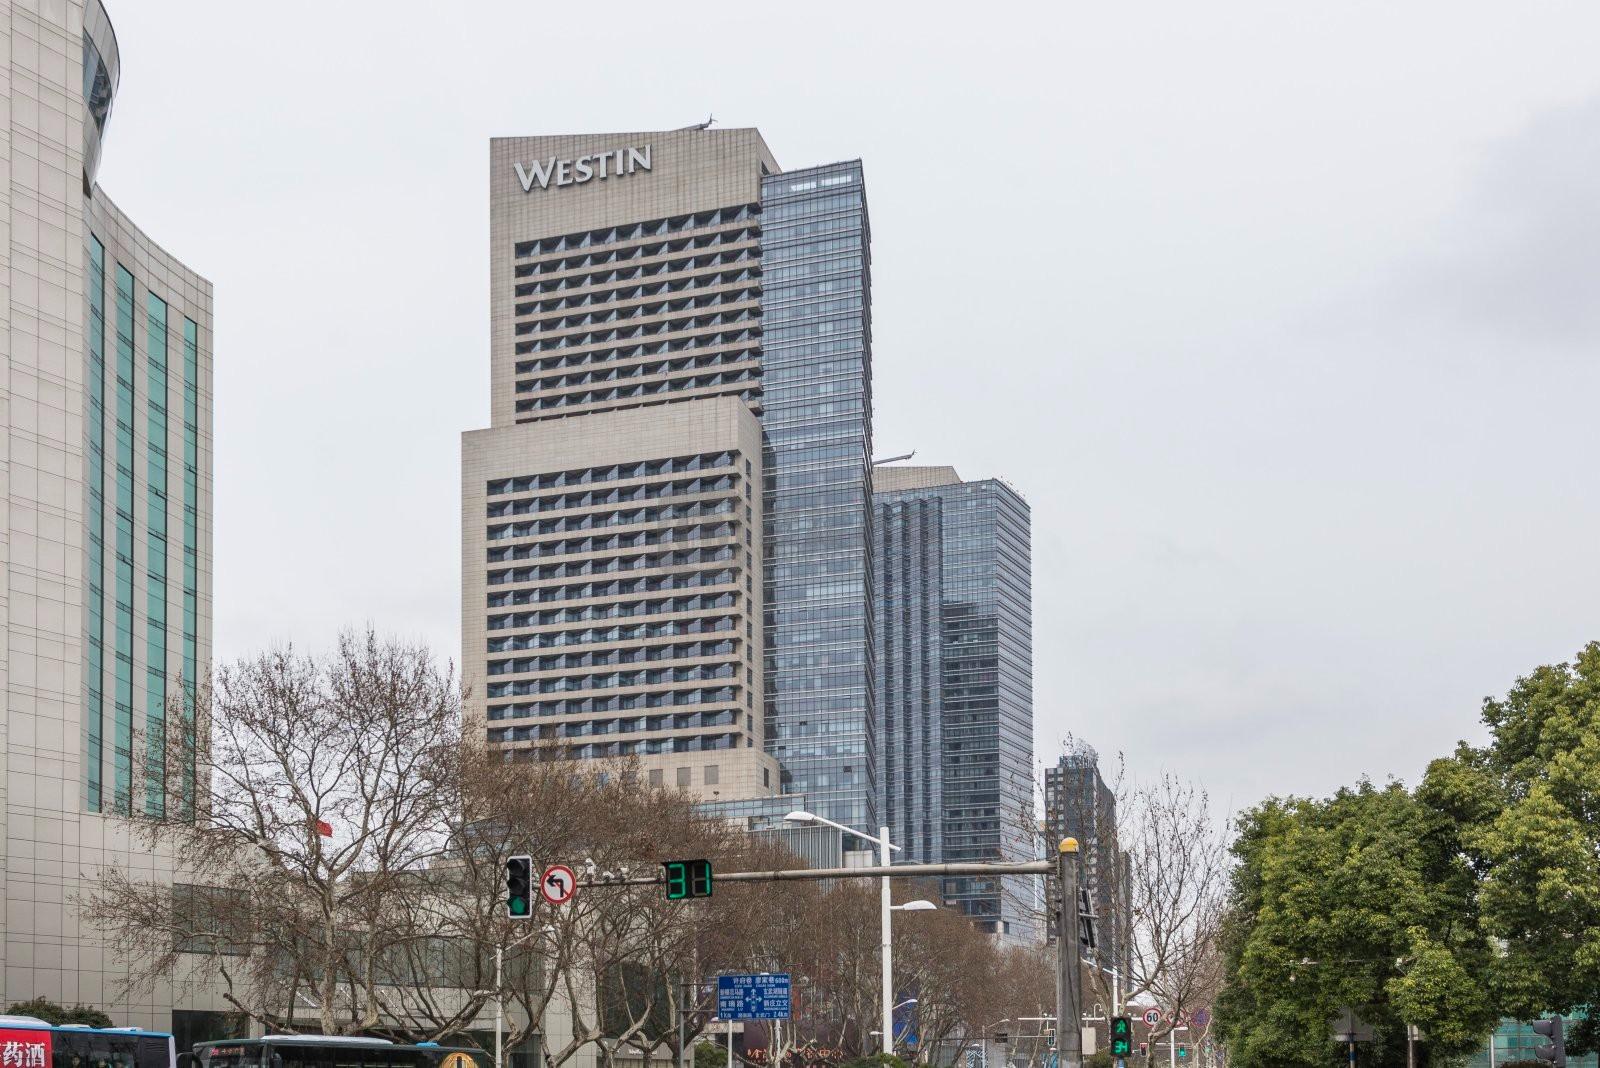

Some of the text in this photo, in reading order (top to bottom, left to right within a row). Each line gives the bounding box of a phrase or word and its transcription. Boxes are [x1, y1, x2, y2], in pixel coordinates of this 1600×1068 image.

[513, 143, 652, 192] WESTIN
[668, 863, 711, 898] 31
[1146, 1012, 1159, 1022] 60
[0, 1041, 46, 1068] 药酒
